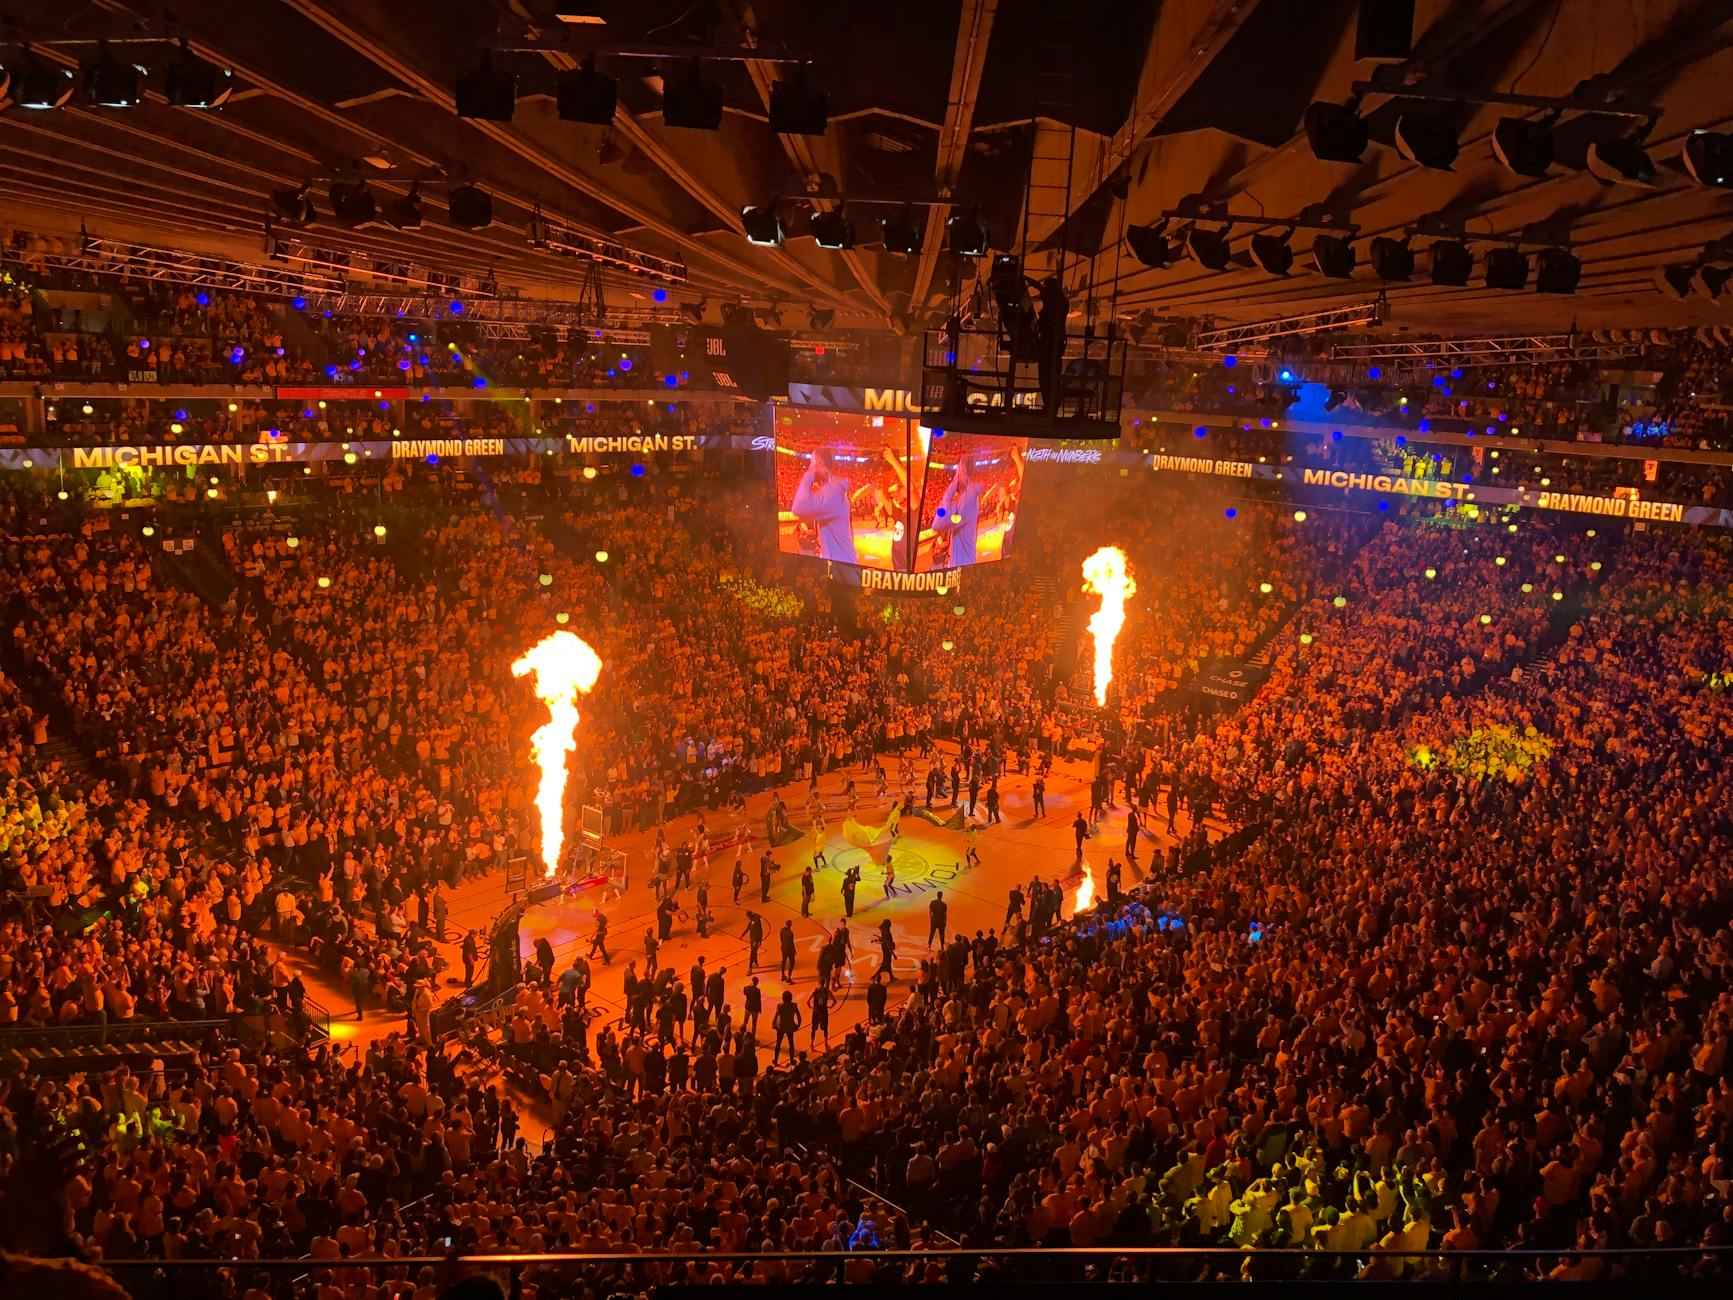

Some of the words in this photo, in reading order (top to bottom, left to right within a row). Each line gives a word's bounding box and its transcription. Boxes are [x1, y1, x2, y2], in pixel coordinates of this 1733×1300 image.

[706, 337, 727, 356] JBL
[712, 372, 737, 388] JBL
[392, 441, 462, 458] DRAYMOND
[465, 439, 504, 456] GREEN
[570, 436, 668, 453] MICHIGAN
[671, 436, 698, 451] ST.
[74, 446, 242, 468] MICHIGAN
[250, 443, 292, 463] ST.
[1152, 455, 1214, 477] DRAYMOND
[1215, 460, 1253, 478] GREEN
[1303, 468, 1429, 496] MICHIGAN
[1434, 482, 1471, 500] ST.
[1538, 491, 1626, 517] DRAYMOND
[1628, 500, 1684, 522] GREEN
[861, 568, 944, 591] DRAYMOND
[1201, 686, 1230, 698] CHASE
